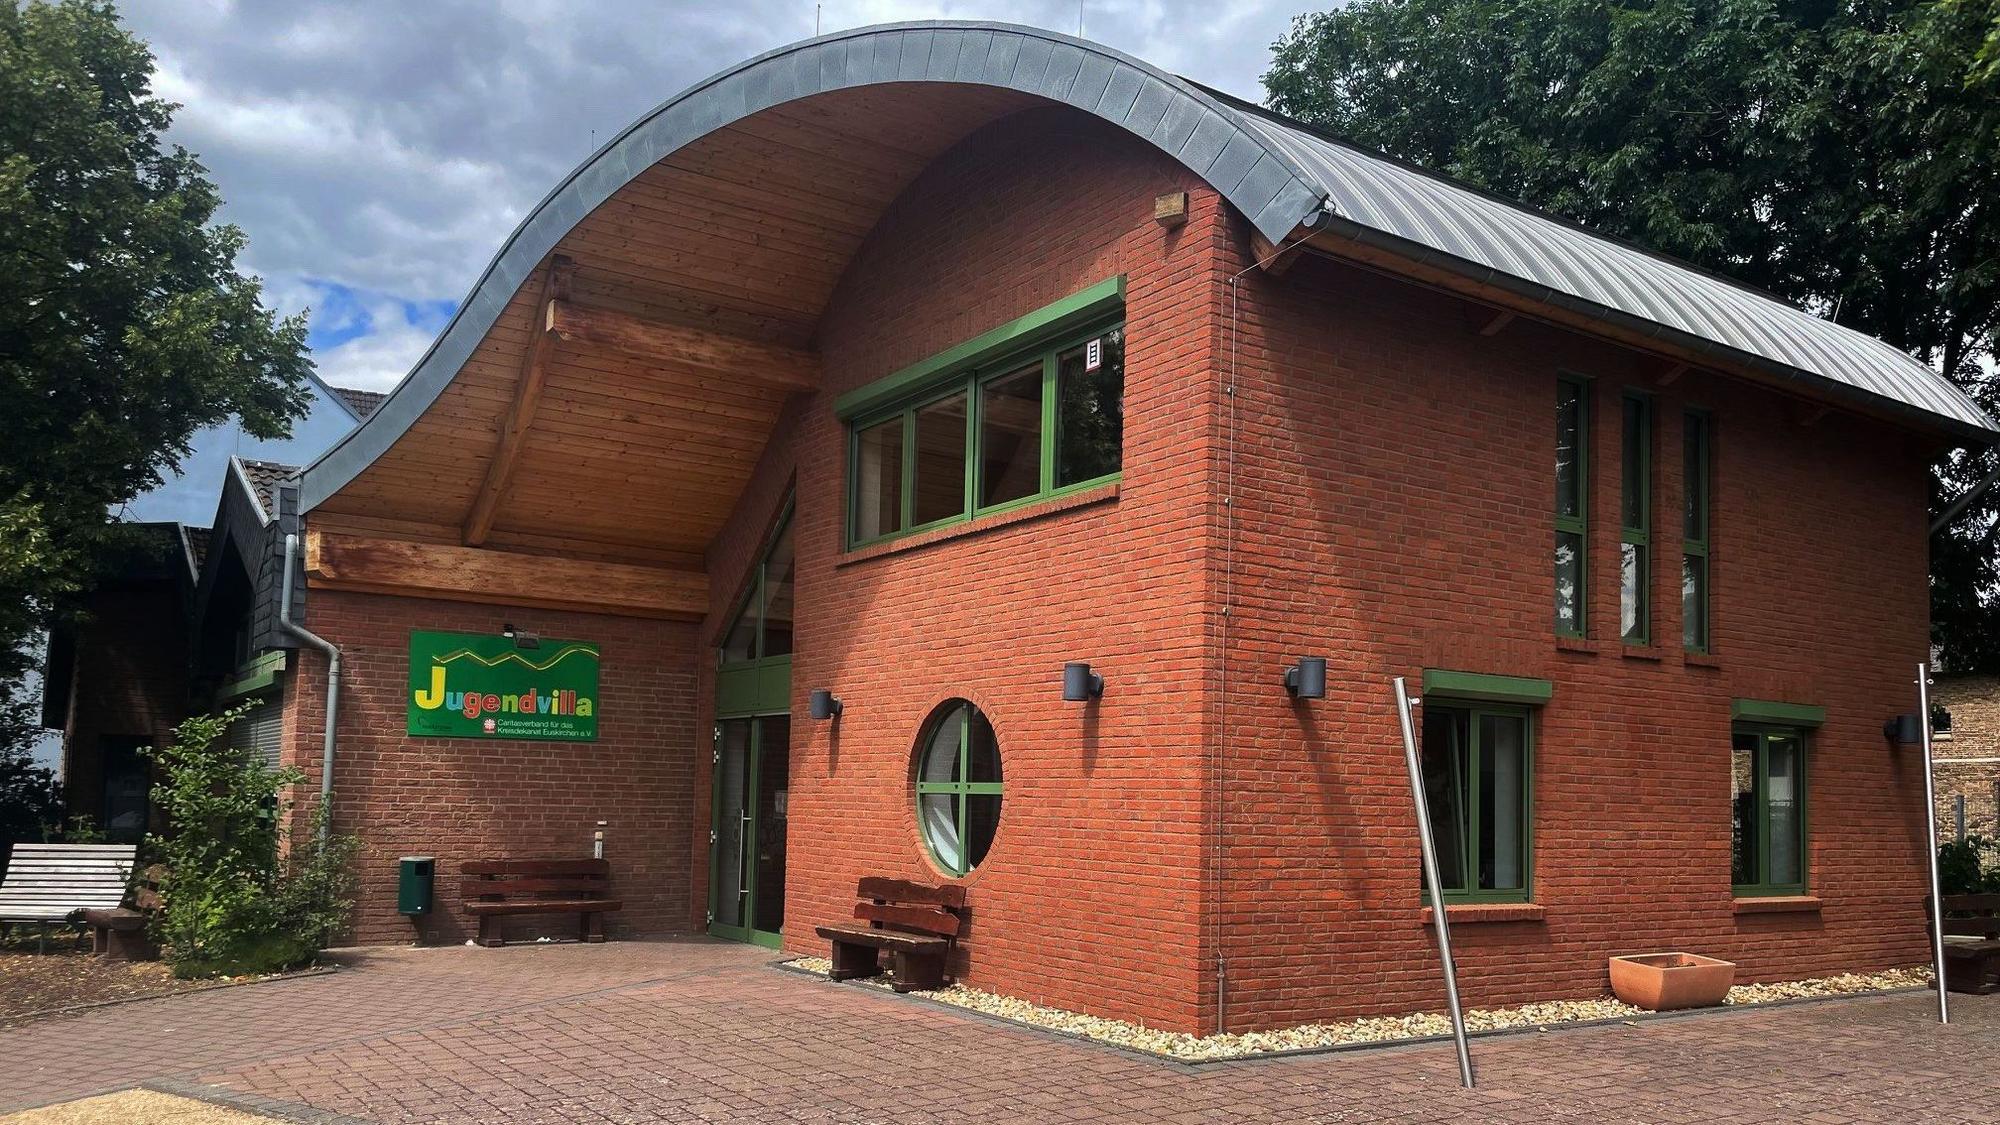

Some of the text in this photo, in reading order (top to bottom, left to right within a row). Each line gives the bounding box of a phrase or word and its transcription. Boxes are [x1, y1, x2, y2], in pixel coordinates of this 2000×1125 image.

[415, 666, 593, 719] Jugendvilla
[498, 719, 549, 728] Caritasverband
[497, 727, 542, 736] Kreisdekanat
[543, 728, 579, 737] Euskirchen
